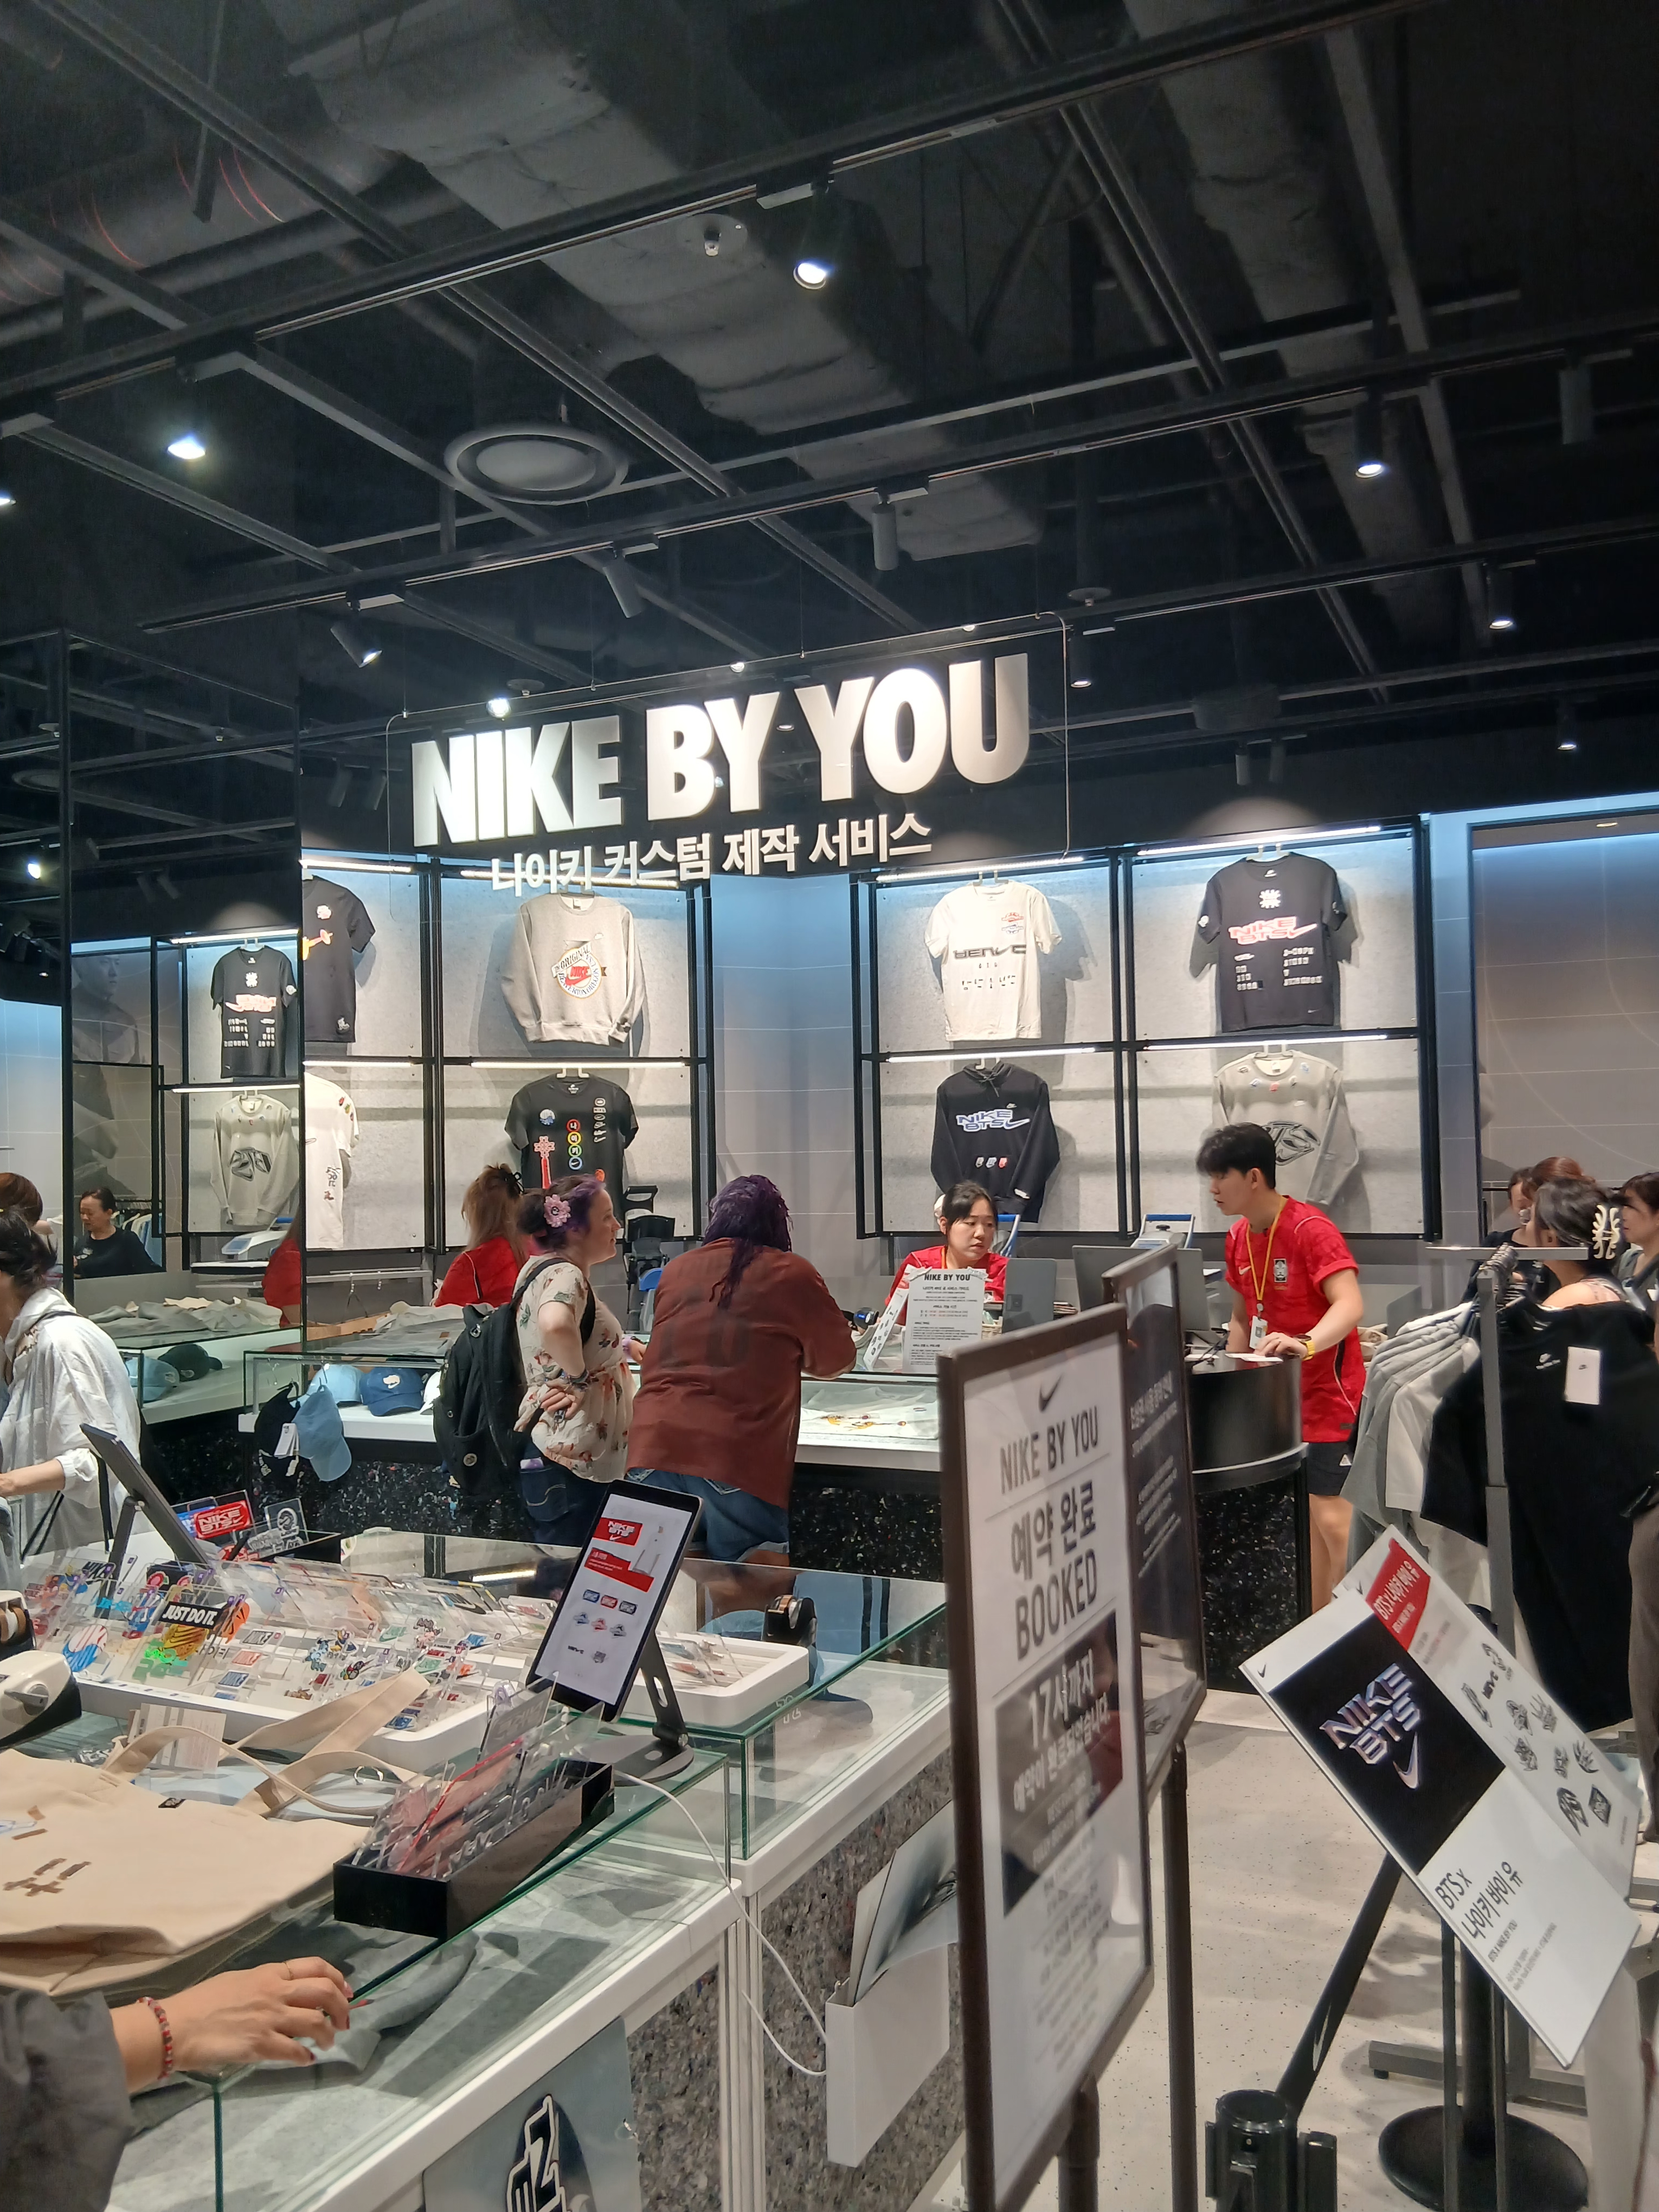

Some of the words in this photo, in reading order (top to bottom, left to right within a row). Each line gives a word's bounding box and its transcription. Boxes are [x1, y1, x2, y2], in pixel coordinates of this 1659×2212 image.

[411, 716, 622, 846] NIKE
[646, 691, 780, 821] BY
[795, 653, 1028, 801] YOU
[491, 846, 594, 898] 나이키
[603, 832, 711, 885] 커스텀
[722, 825, 799, 877] 제작
[809, 813, 932, 867] 서비스
[1231, 917, 1295, 937] NIKE
[1239, 929, 1288, 943] BTS
[561, 945, 590, 969] ORIGINAL
[570, 966, 589, 977] NIKE
[957, 1110, 1012, 1125] NIKE
[964, 1119, 1006, 1131] BTS
[999, 1431, 1040, 1495] NIKE
[1046, 1420, 1066, 1471] BY
[1071, 1405, 1099, 1458] YOU
[199, 1509, 241, 1526] NIKE
[201, 1517, 233, 1532] BTS
[608, 1521, 635, 1533] NIKE
[1011, 1499, 1053, 1581] 예약
[1060, 1480, 1096, 1553] 완료
[162, 1605, 188, 1622] JUST
[186, 1609, 204, 1625] DO
[203, 1611, 218, 1626] IT.
[1015, 1548, 1098, 1661] BOOKED
[1374, 1595, 1394, 1620] BTS
[1028, 1648, 1096, 1751] 17시까지
[1320, 1663, 1412, 1750] NIKE
[1349, 1695, 1423, 1766] BTS
[1013, 1752, 1047, 1814] 예약이
[1435, 1873, 1464, 1910] BTS
[1461, 1892, 1501, 1939] 나이키
[1486, 1870, 1516, 1905] 바이
[1501, 1861, 1523, 1887] 유
